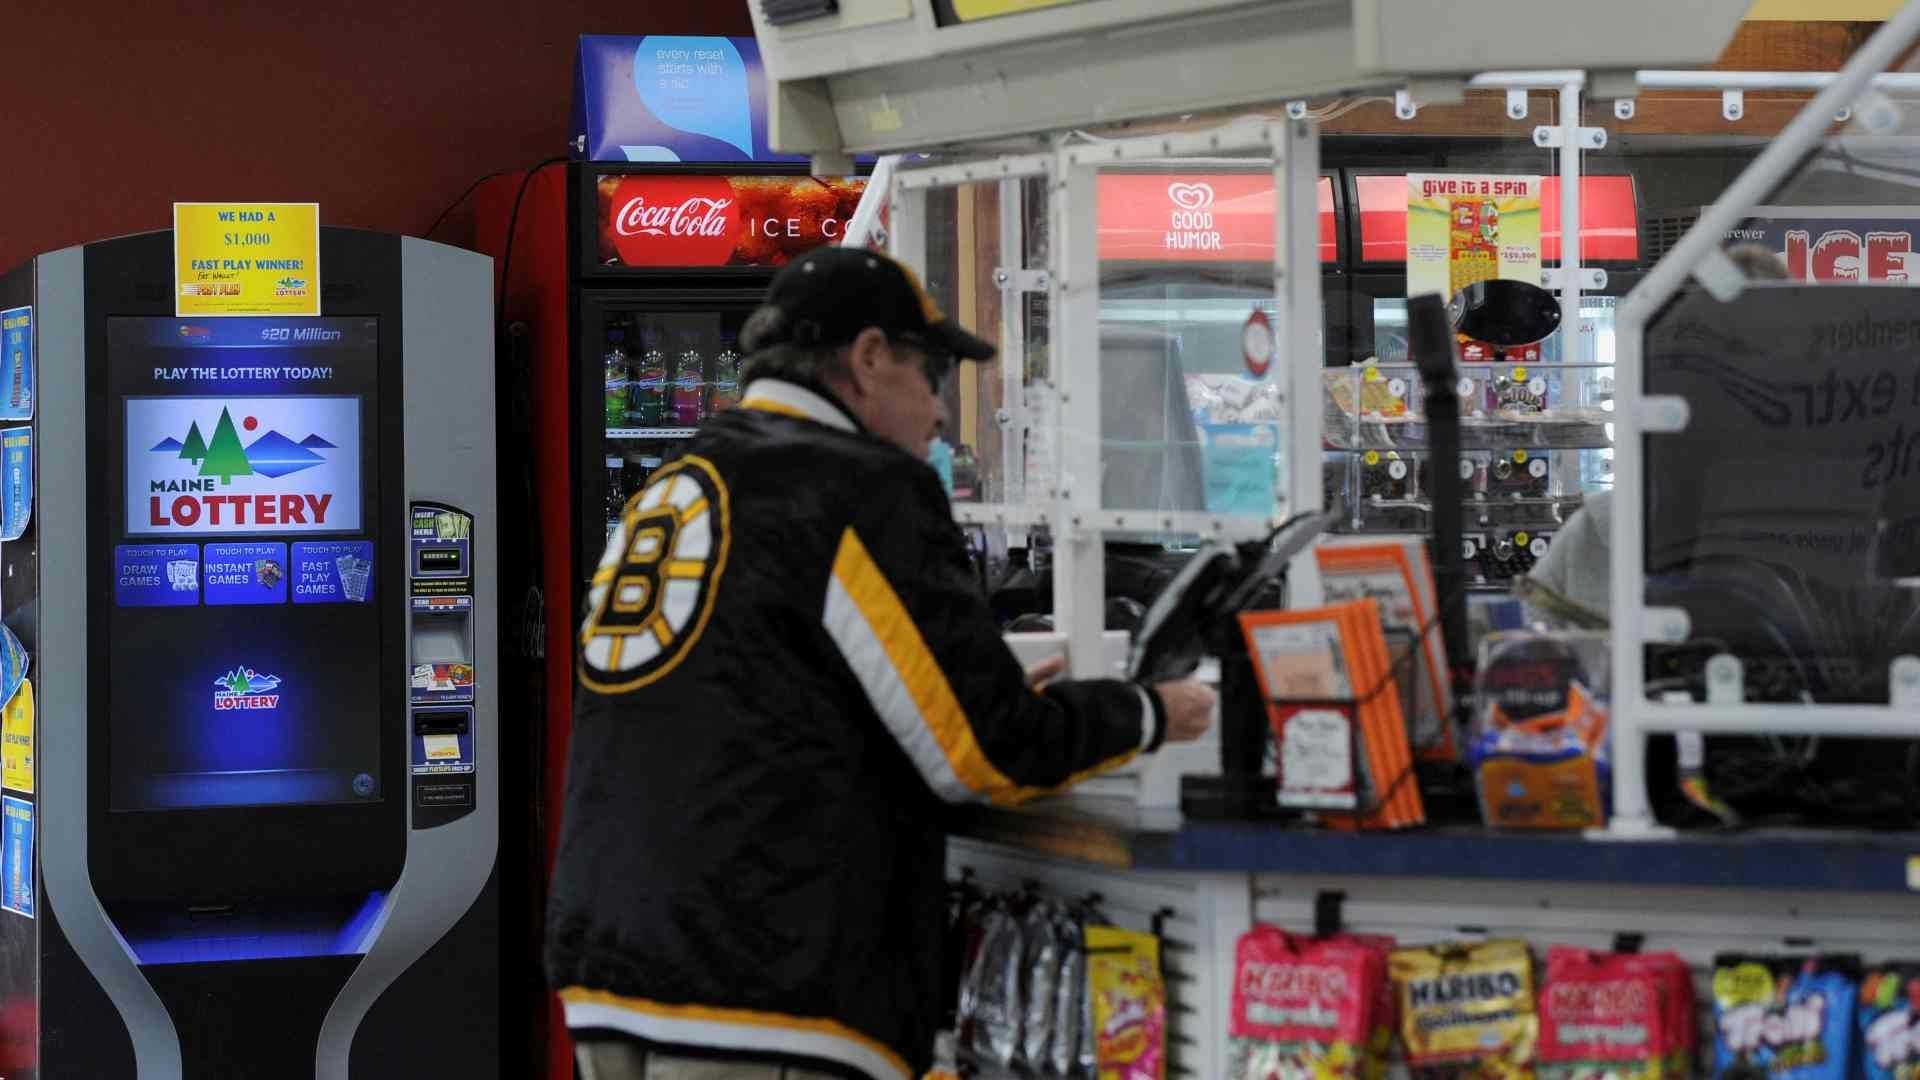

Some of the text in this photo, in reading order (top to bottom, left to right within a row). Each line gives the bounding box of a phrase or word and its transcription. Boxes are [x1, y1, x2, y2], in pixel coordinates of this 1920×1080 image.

[1423, 180, 1457, 197] give
[1461, 180, 1476, 194] it
[1481, 181, 1489, 194] a
[218, 211, 276, 222] WE HAD A
[616, 196, 733, 237] Coca-Cola
[1171, 211, 1213, 230] GOOD
[750, 218, 801, 237] ICE
[224, 232, 270, 247] $1,000
[1166, 231, 1221, 250] HUMOR
[1721, 229, 1765, 240] rewer
[1784, 230, 1911, 284] ICE
[191, 259, 304, 270] FAST PLAY WINNER!
[260, 328, 341, 341] $20 Million
[154, 367, 333, 380] PLAY THE LOTTERY TODAY!
[150, 478, 214, 492] MAINE
[150, 494, 332, 527] LOTTERY
[128, 549, 188, 557] TOUCH TO PLAY
[215, 548, 276, 556] TOUCH TO PLAY
[303, 546, 362, 554] TOUCH TO PLAY
[123, 564, 159, 575] DRAW
[205, 562, 252, 574] INSTANT
[302, 561, 330, 572] FAST
[119, 576, 161, 587] GAMES
[208, 575, 249, 585] GAMES
[302, 572, 330, 583] PLAY
[296, 584, 336, 595] GAMES
[215, 696, 279, 710] LOTTERY
[1409, 968, 1521, 1006] HARIBO
